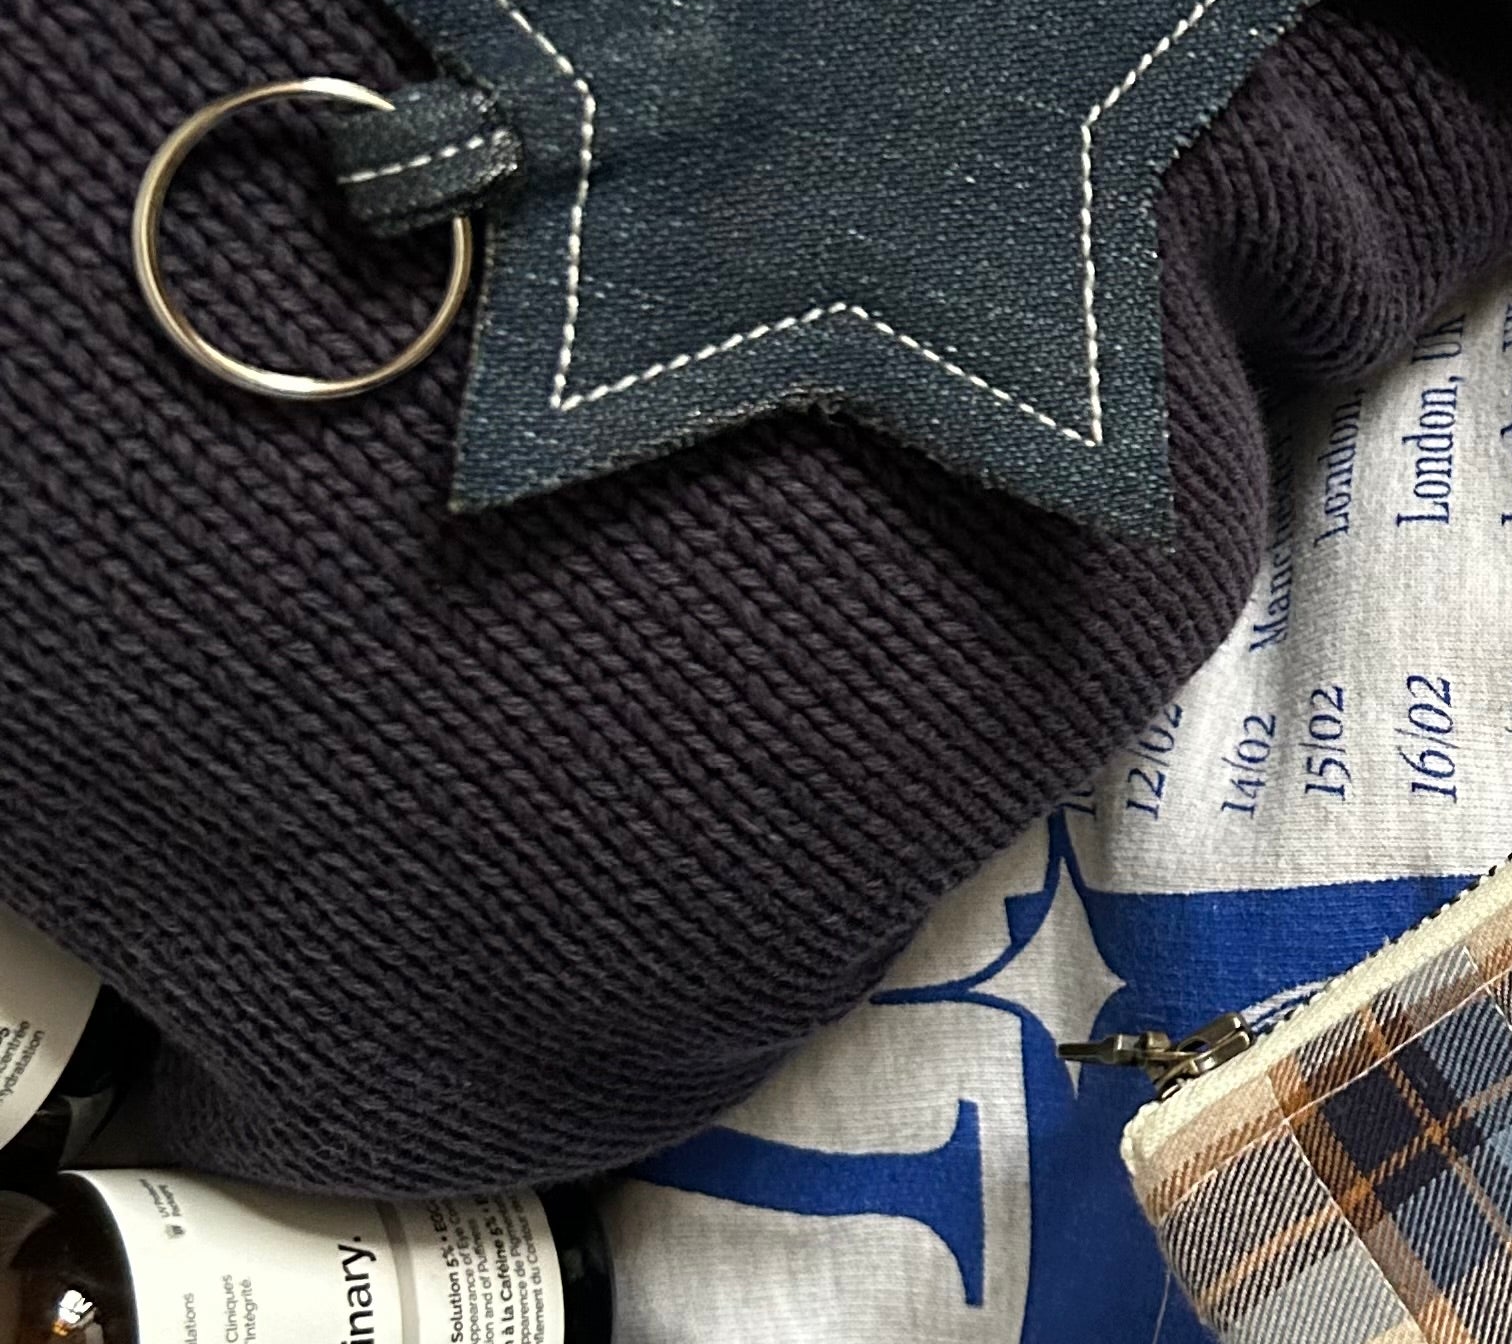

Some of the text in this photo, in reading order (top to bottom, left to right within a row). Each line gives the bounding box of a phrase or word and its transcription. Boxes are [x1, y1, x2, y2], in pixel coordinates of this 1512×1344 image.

[1397, 374, 1463, 527] London,
[1304, 684, 1352, 801] 15/02
[1400, 673, 1461, 803] 16/02
[1221, 715, 1276, 819] 14/02
[483, 1216, 503, 1235] 5%
[456, 1227, 469, 1249] Eye
[441, 1245, 459, 1267] 5%
[460, 1252, 472, 1265] of
[495, 1239, 513, 1301] Caféine
[513, 1260, 526, 1277] de
[531, 1267, 542, 1285] du
[479, 1276, 491, 1289] of
[222, 1274, 239, 1344] Cliniques
[448, 1272, 464, 1343] Solution
[482, 1292, 494, 1318] and
[501, 1305, 514, 1322] la
[501, 1325, 514, 1335] à
